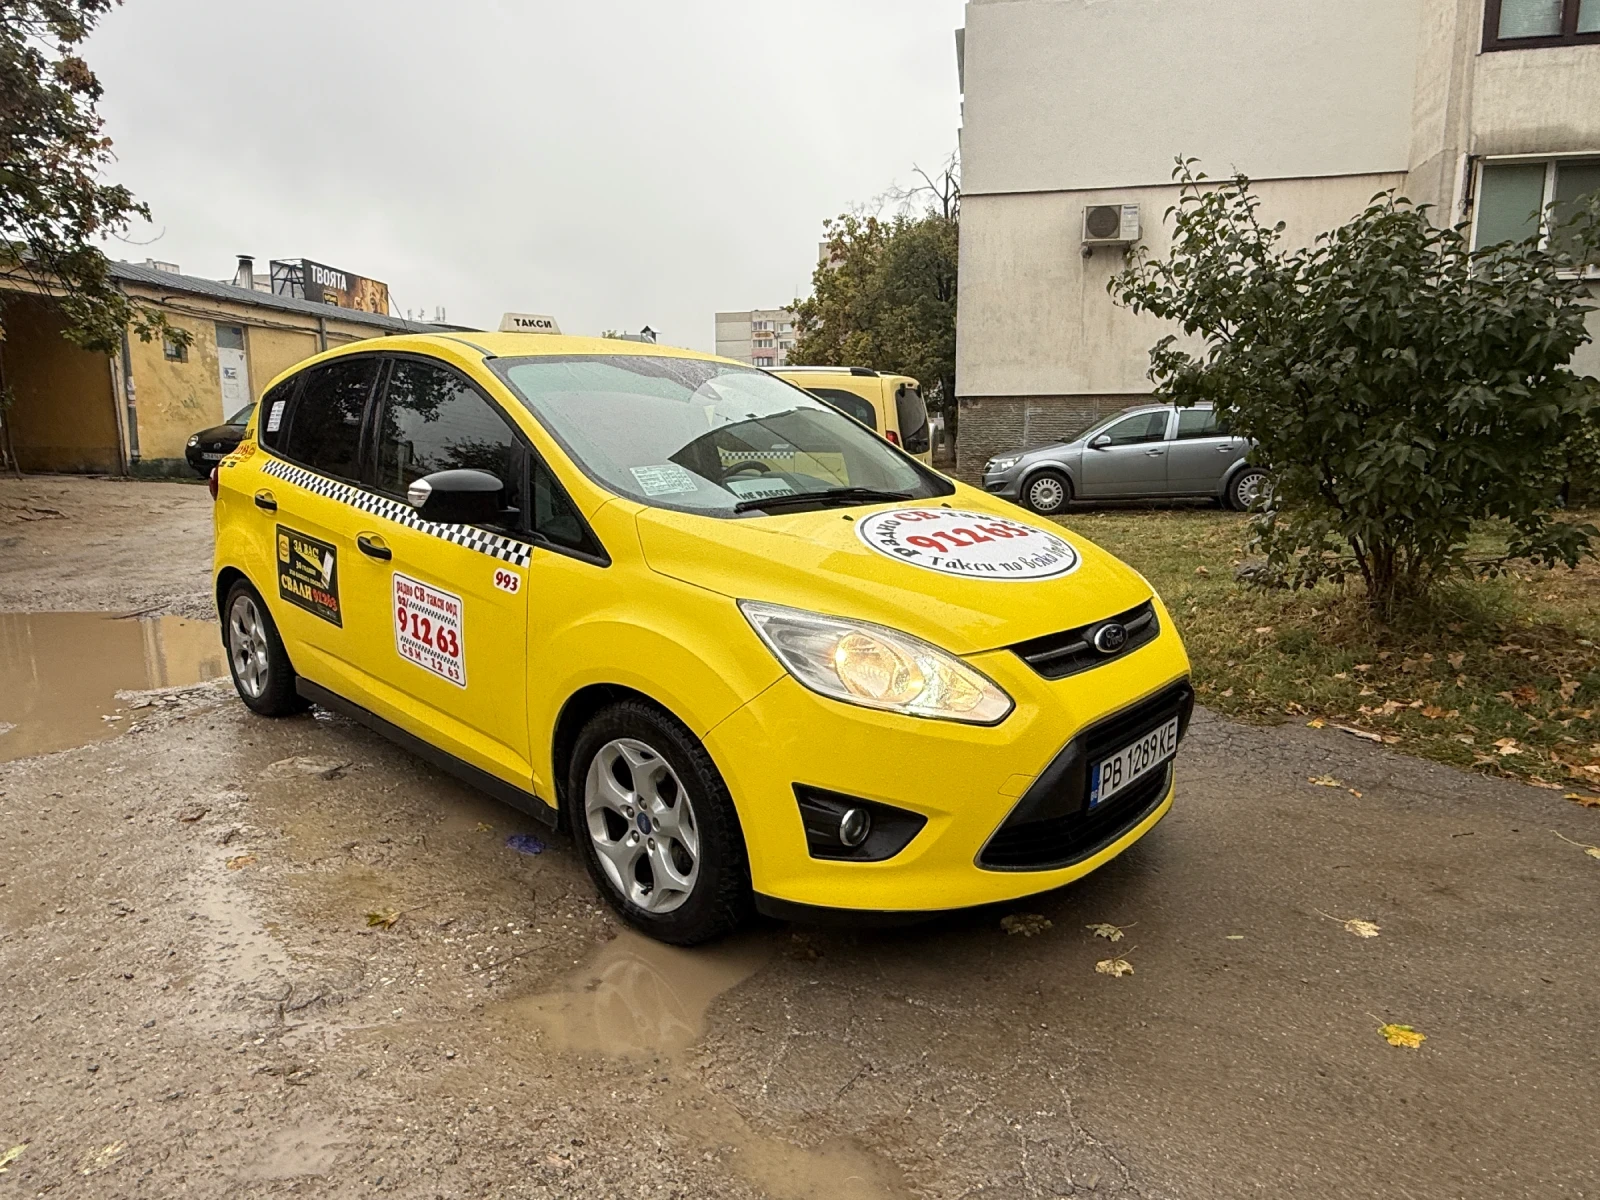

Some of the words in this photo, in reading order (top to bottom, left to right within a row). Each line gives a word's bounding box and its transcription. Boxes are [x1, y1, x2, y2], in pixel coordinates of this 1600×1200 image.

[310, 264, 347, 292] ТВОЯТА
[513, 318, 553, 329] ТАКСИ
[740, 491, 757, 500] НЕ
[905, 522, 1029, 553] 91263
[495, 571, 518, 592] 993
